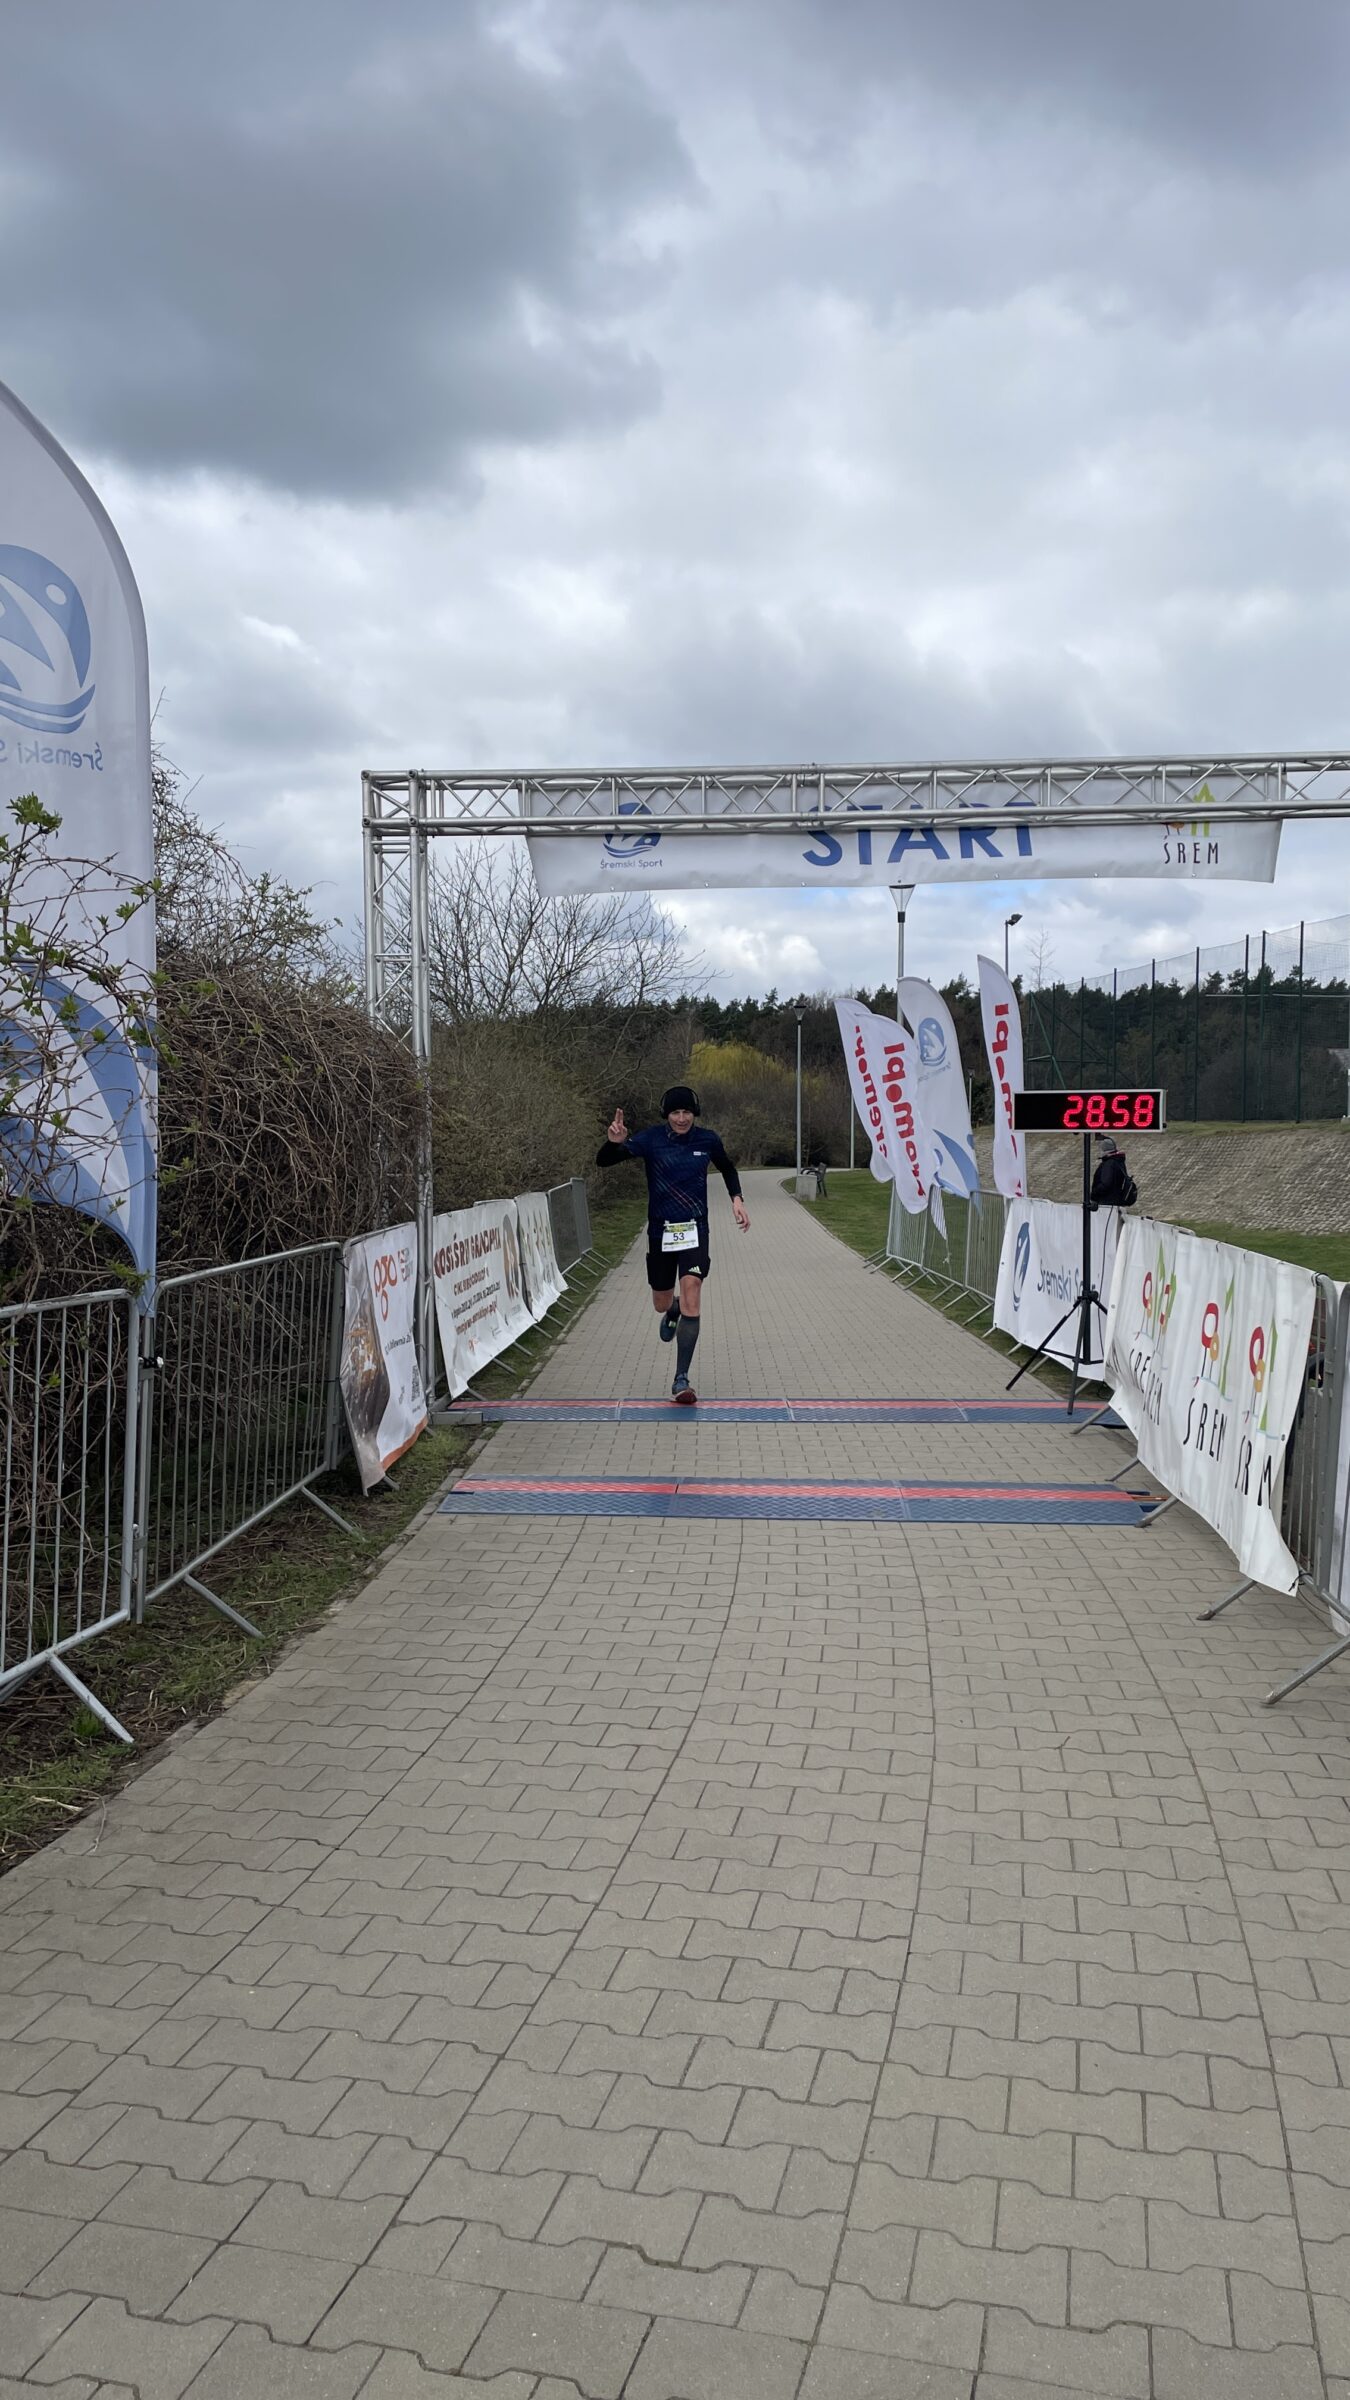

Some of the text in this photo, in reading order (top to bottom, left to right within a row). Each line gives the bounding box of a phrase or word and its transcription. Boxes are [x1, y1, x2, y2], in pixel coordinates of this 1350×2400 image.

[802, 803, 1037, 867] START
[1163, 836, 1219, 865] ŚREM
[600, 857, 663, 869] Śremski Sport
[1063, 1094, 1154, 1128] 28.58
[673, 1232, 685, 1242] 53
[1233, 1410, 1272, 1510] ŚRM
